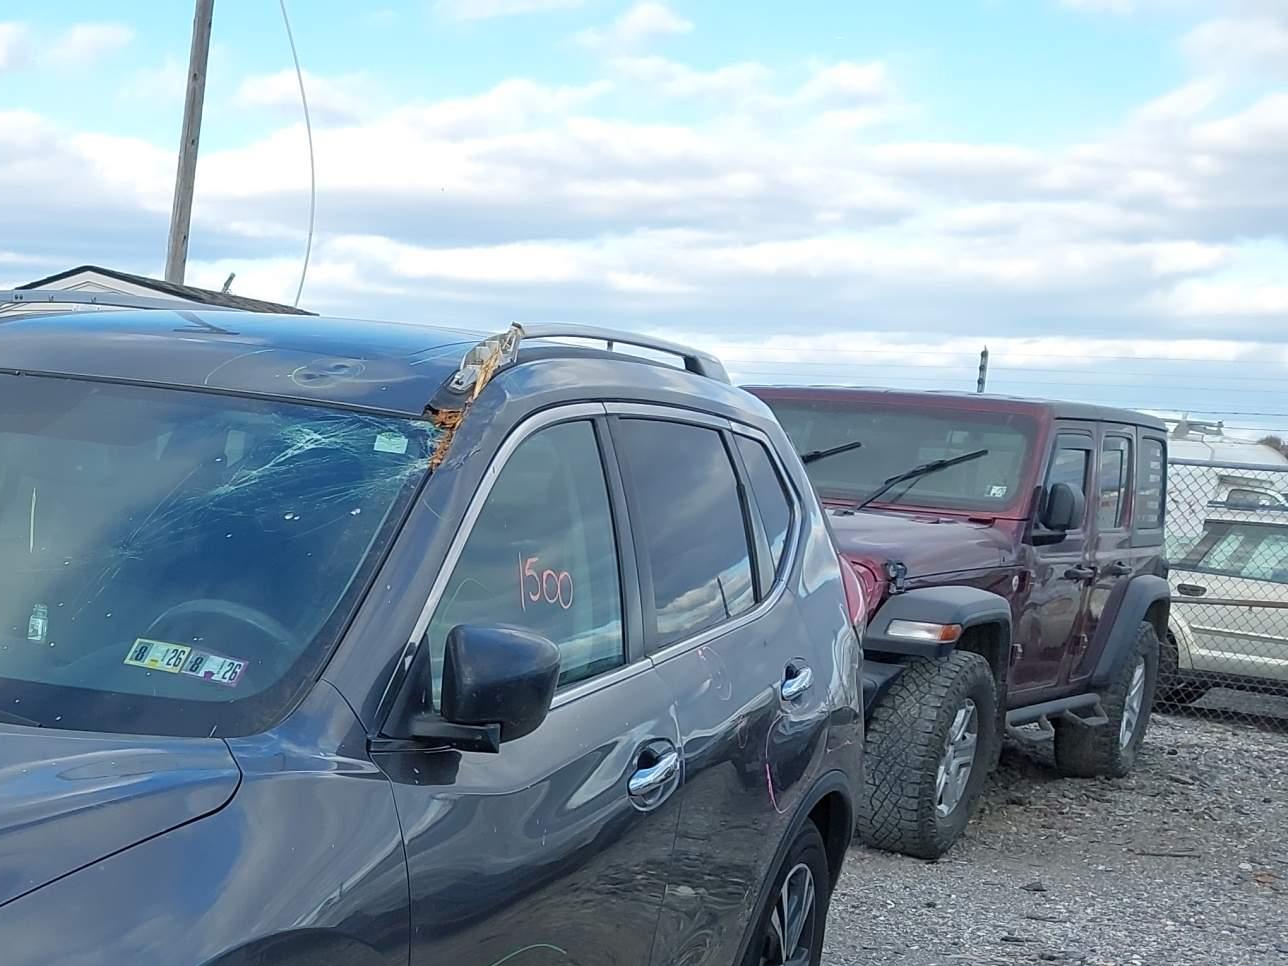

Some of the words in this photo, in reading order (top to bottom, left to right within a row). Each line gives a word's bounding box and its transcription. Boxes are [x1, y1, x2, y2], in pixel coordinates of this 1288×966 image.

[518, 552, 574, 612] 1500
[165, 648, 187, 668] 26
[221, 662, 243, 681] 26
